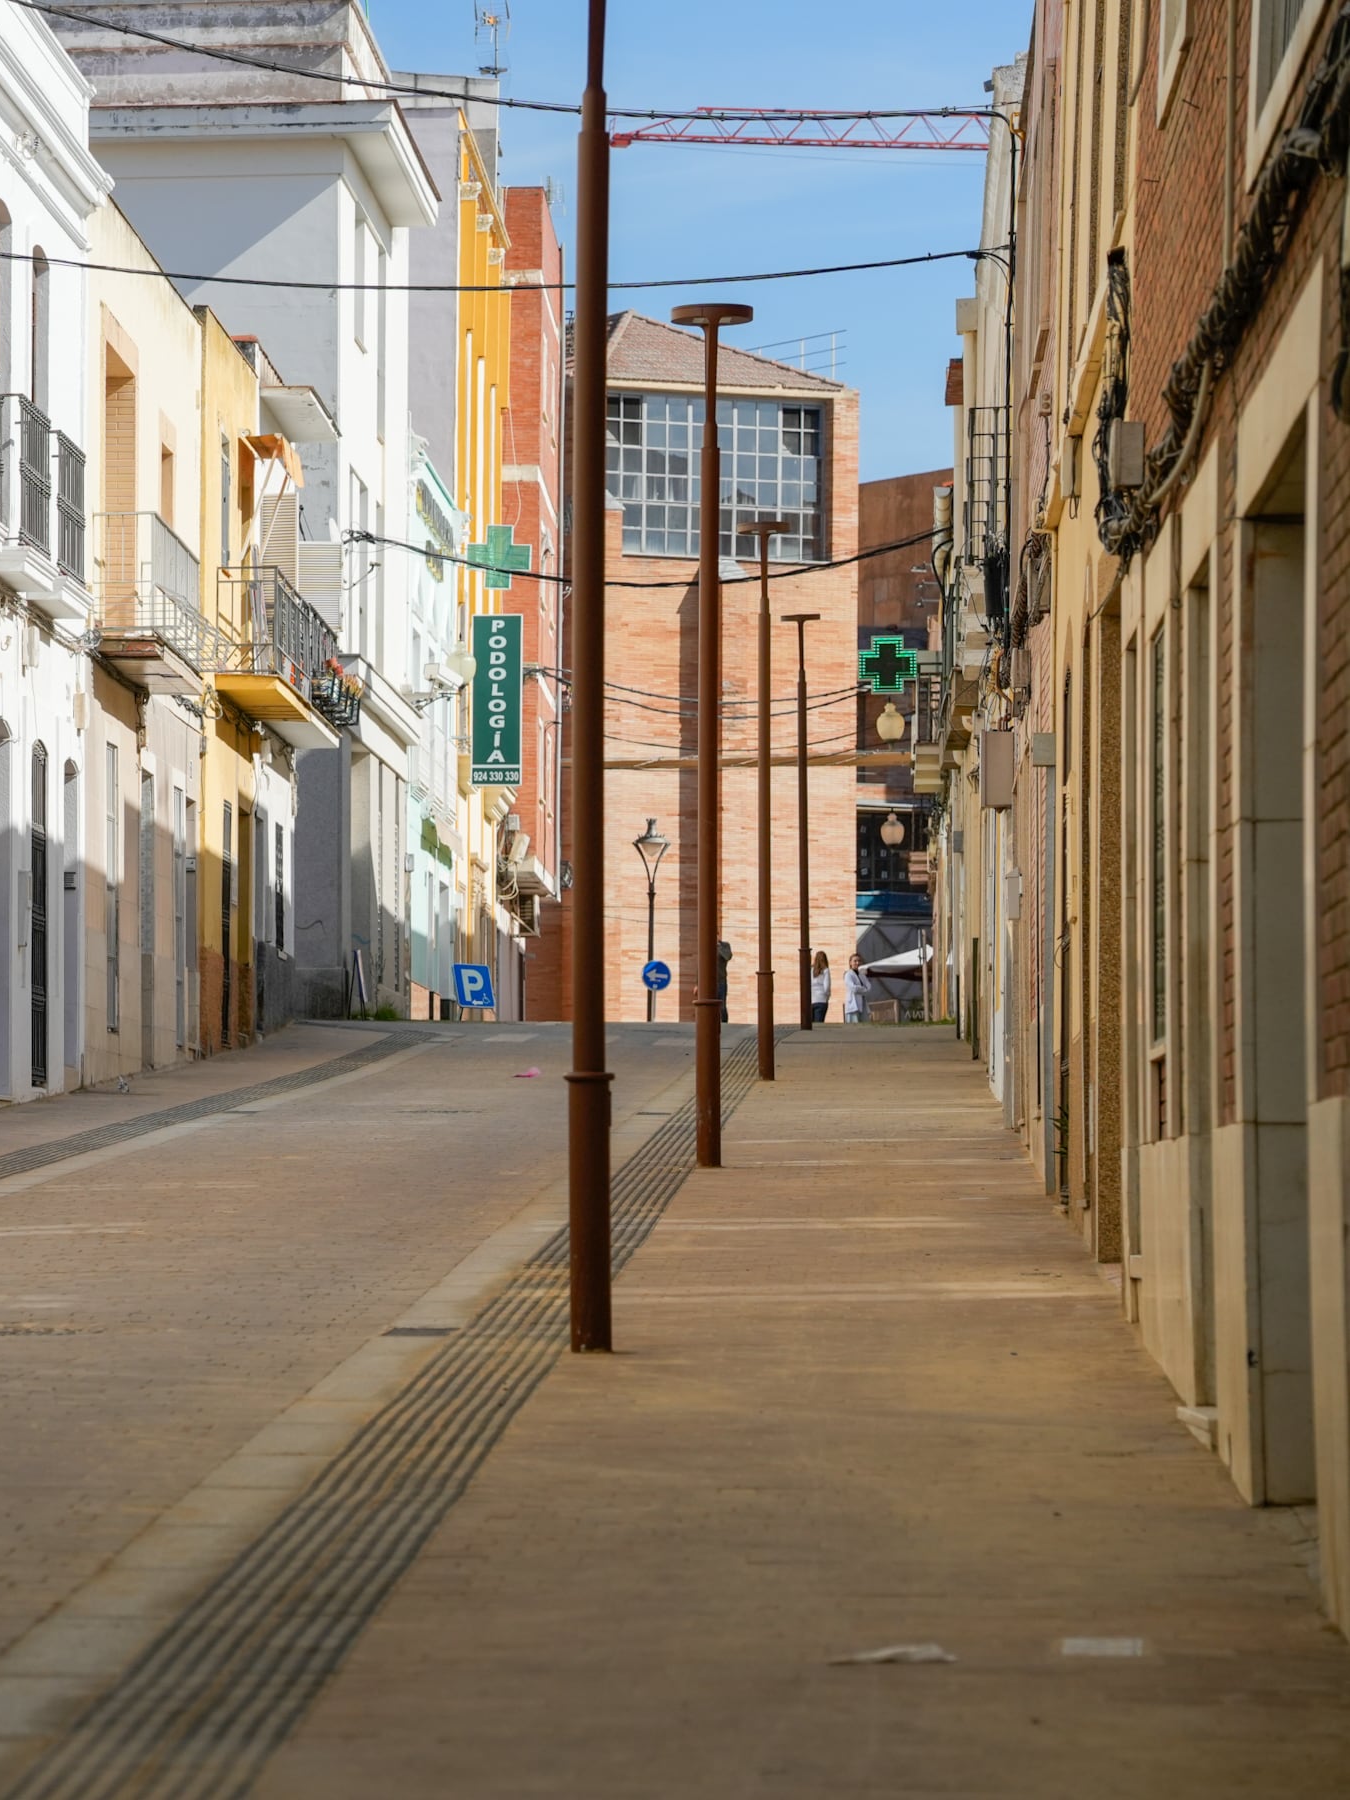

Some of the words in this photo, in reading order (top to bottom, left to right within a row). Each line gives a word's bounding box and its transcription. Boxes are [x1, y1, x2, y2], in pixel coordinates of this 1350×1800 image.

[486, 619, 507, 763] PODOLOGÍA
[473, 771, 488, 782] 924
[489, 771, 504, 782] 330
[504, 771, 519, 782] 330
[461, 968, 484, 1002] P
